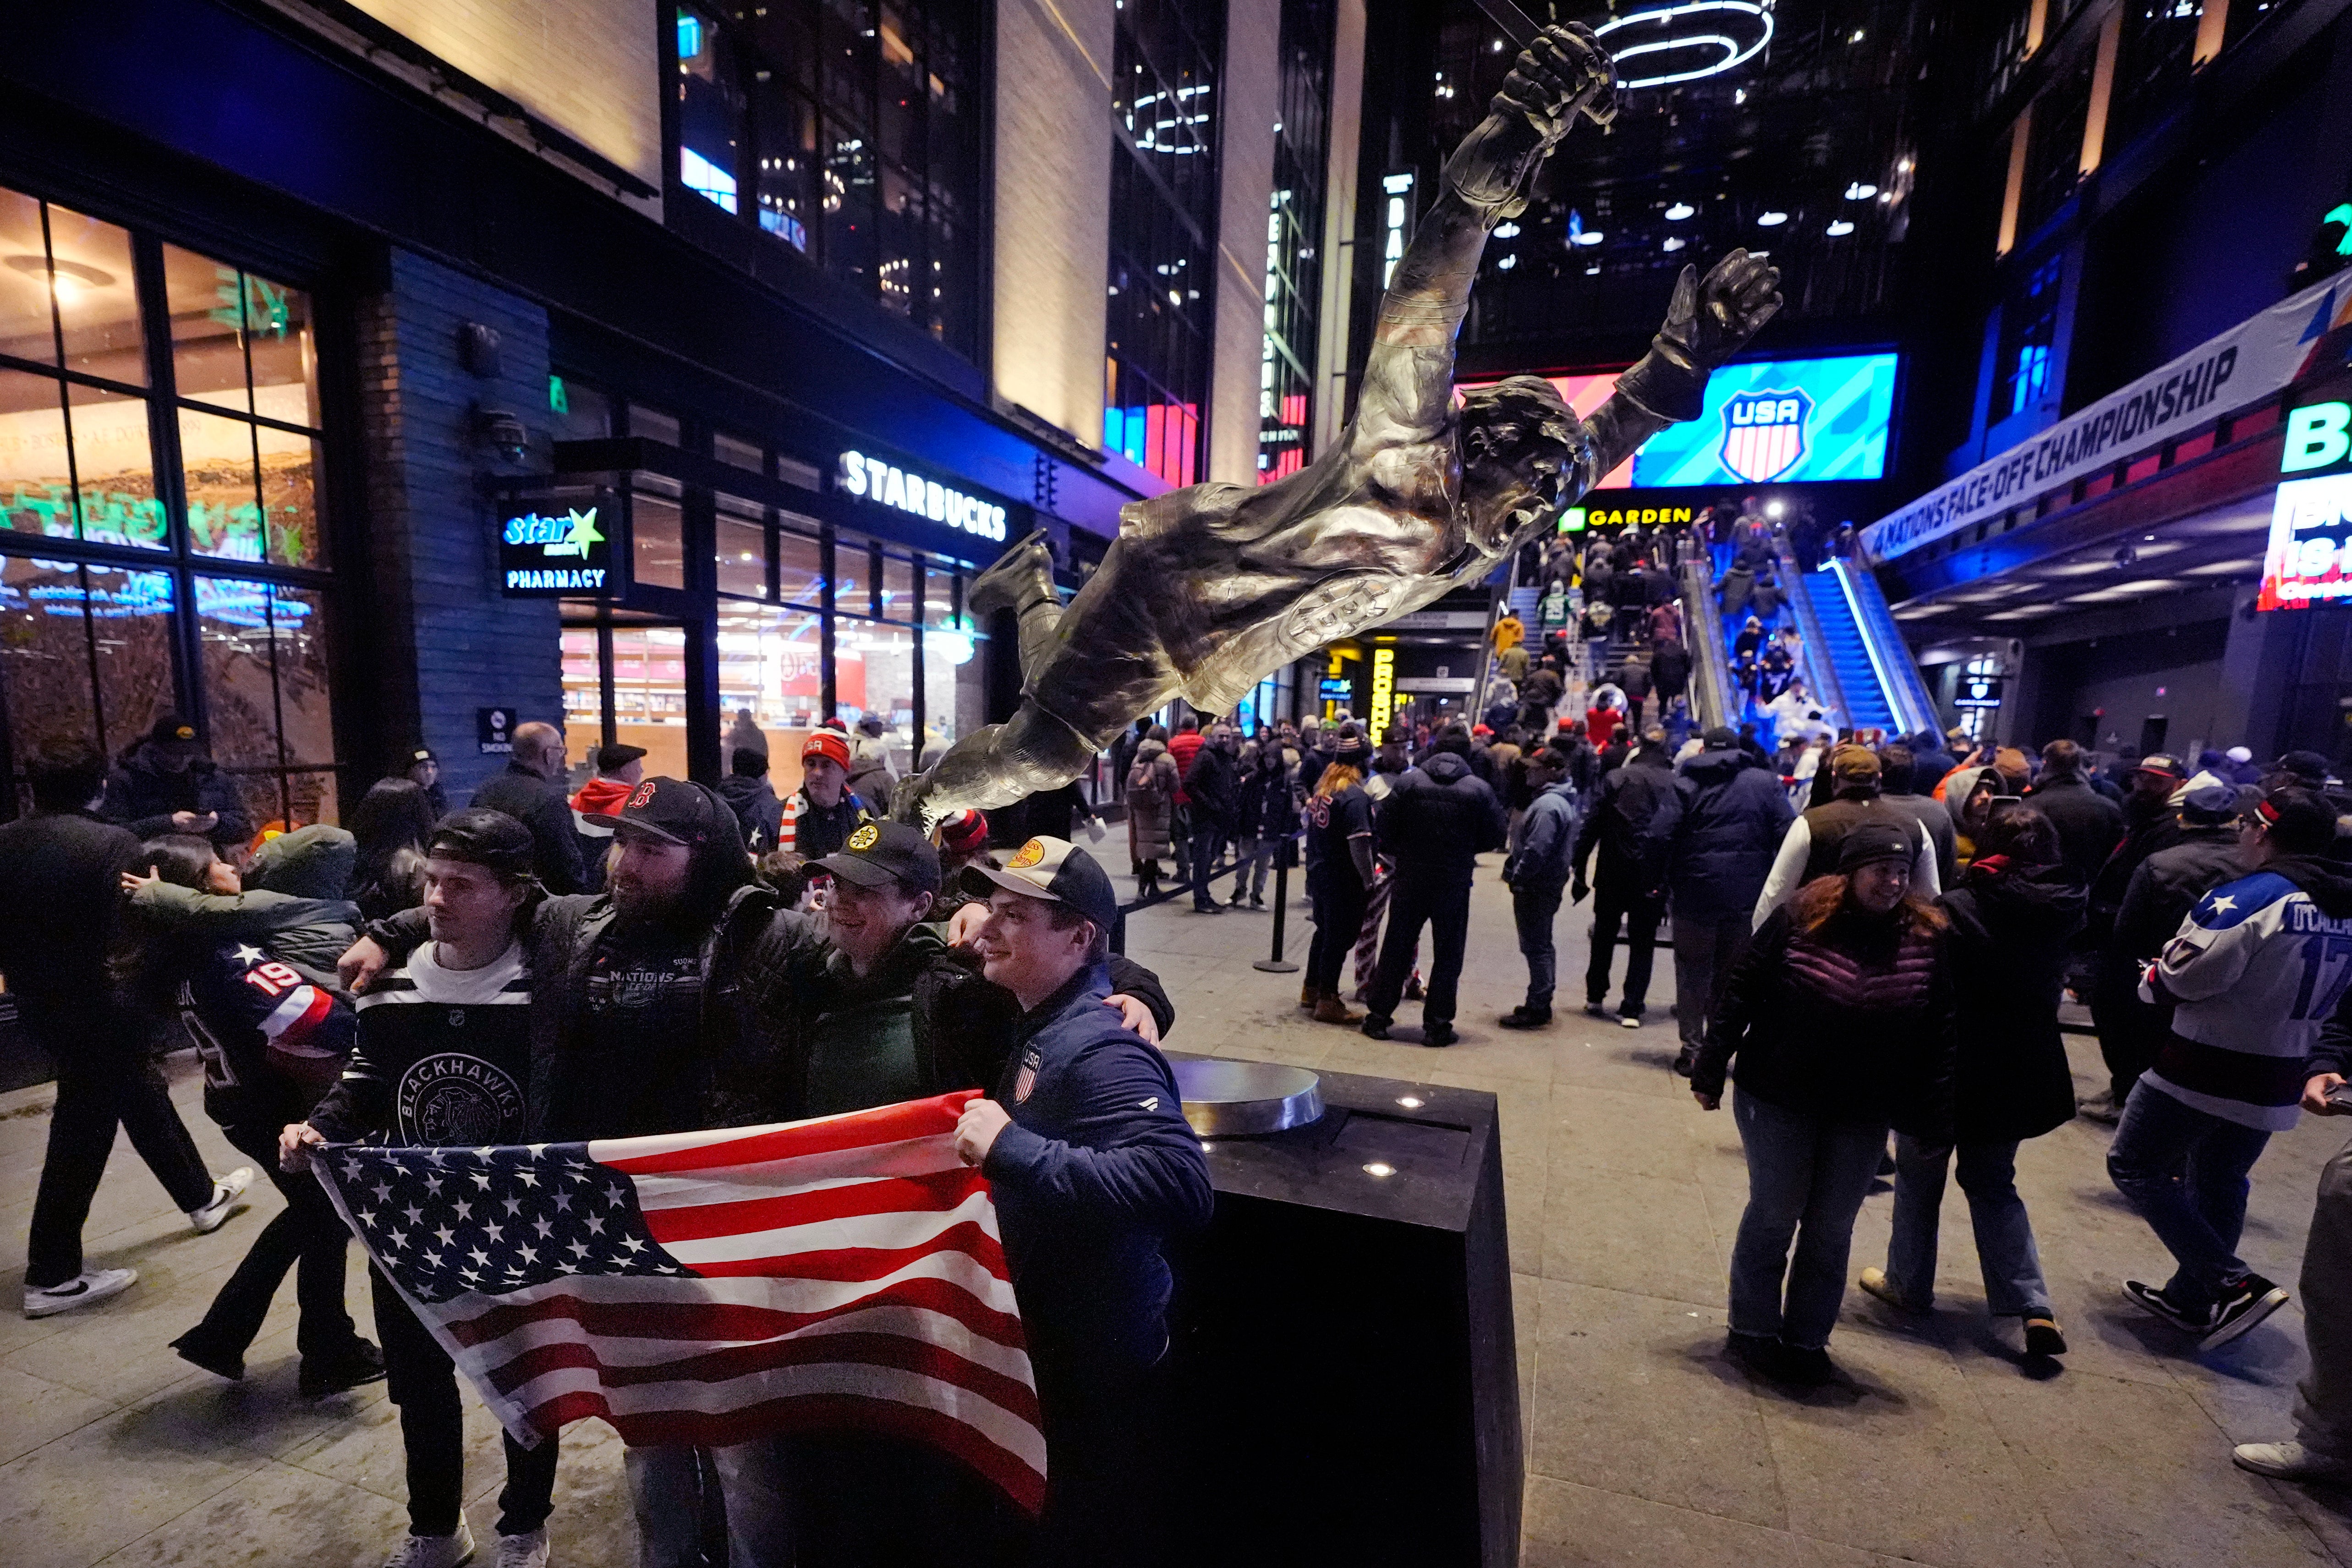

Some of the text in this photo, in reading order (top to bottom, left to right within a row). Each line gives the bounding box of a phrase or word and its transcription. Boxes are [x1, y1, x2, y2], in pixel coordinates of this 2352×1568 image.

[1732, 399, 1800, 425] USA
[1883, 495, 1946, 550] NATIONS
[1946, 450, 2035, 522] FACE-OFF
[2034, 346, 2238, 481] CHAMPIONSHIP
[2281, 401, 2352, 473] B
[846, 450, 1006, 542] STARBUCKS
[503, 512, 573, 544] star
[1588, 507, 1691, 526] GARDEN
[506, 569, 606, 588] PHARMACY
[804, 740, 823, 753] SA
[628, 782, 656, 809] B
[245, 962, 303, 997] 19
[2289, 937, 2352, 1020] 17
[1024, 1048, 1040, 1069] USA
[402, 1059, 519, 1119] BLACKHAWKS
